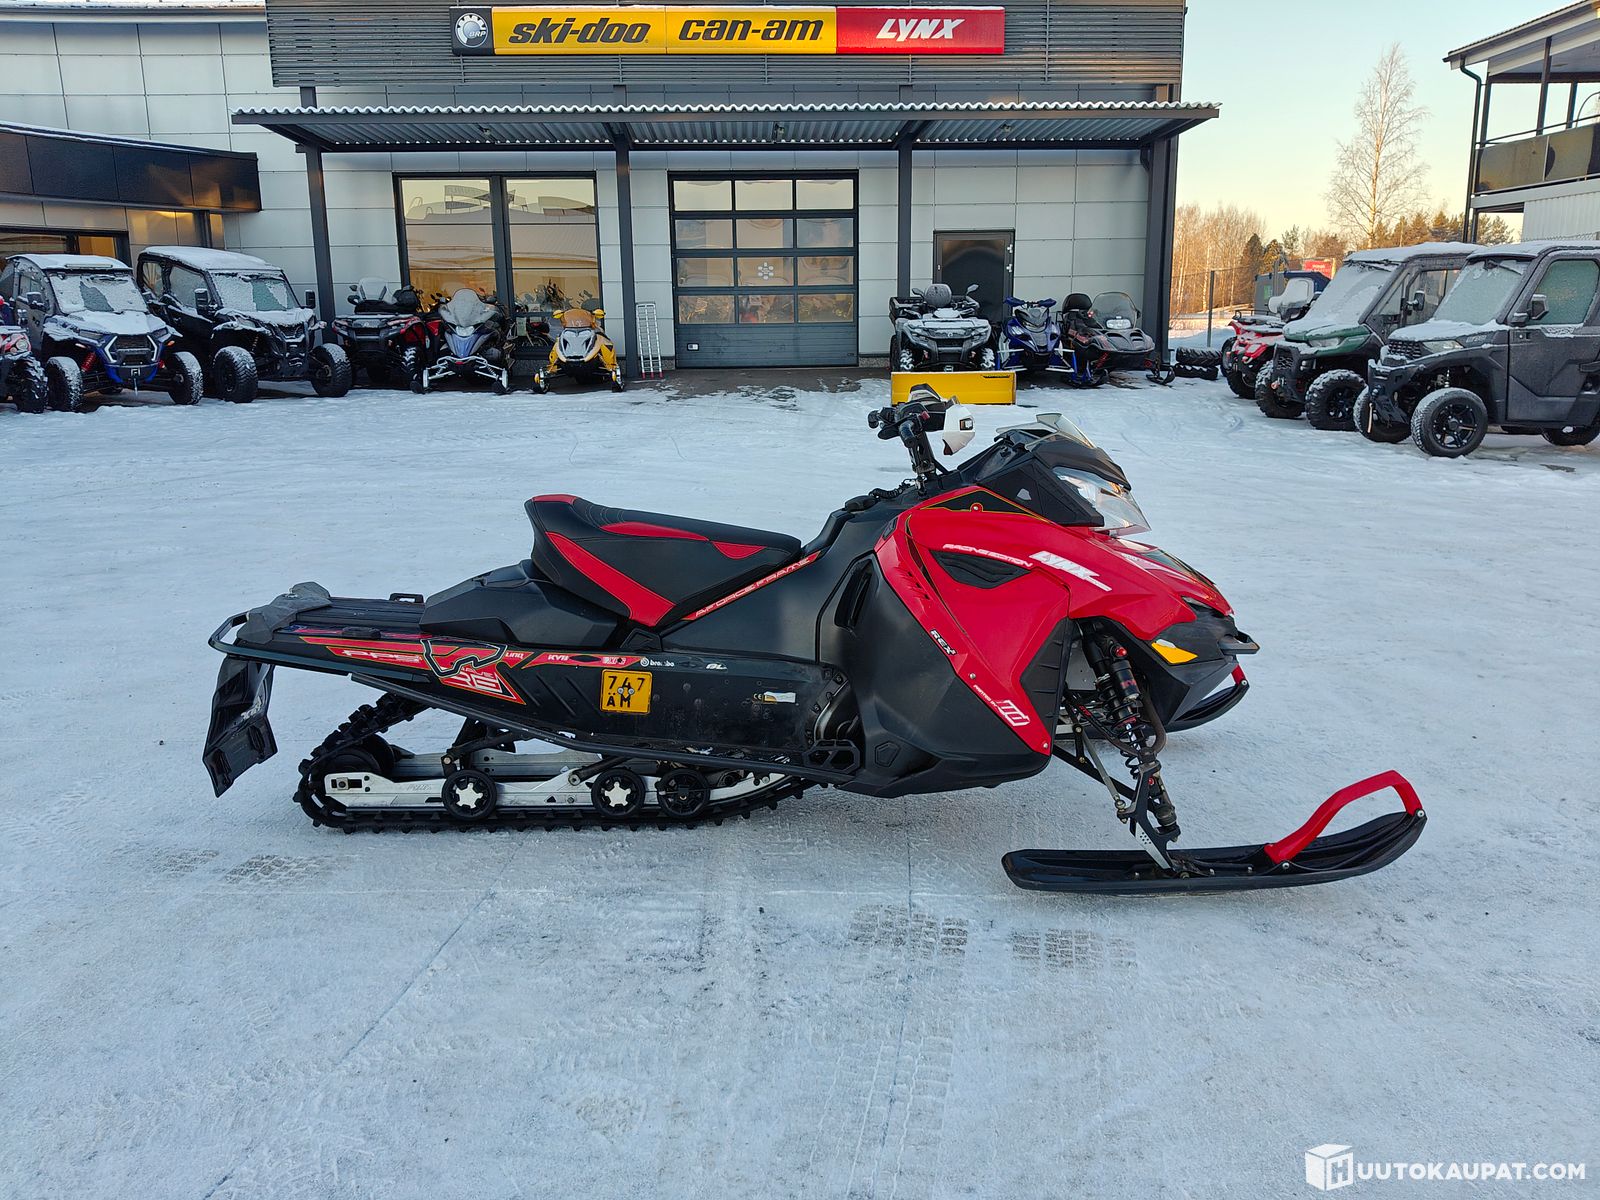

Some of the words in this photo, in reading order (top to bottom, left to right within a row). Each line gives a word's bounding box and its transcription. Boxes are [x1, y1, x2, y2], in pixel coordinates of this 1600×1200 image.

[508, 17, 649, 44] ski-doo
[678, 19, 823, 41] can-am
[876, 18, 965, 42] LYNX
